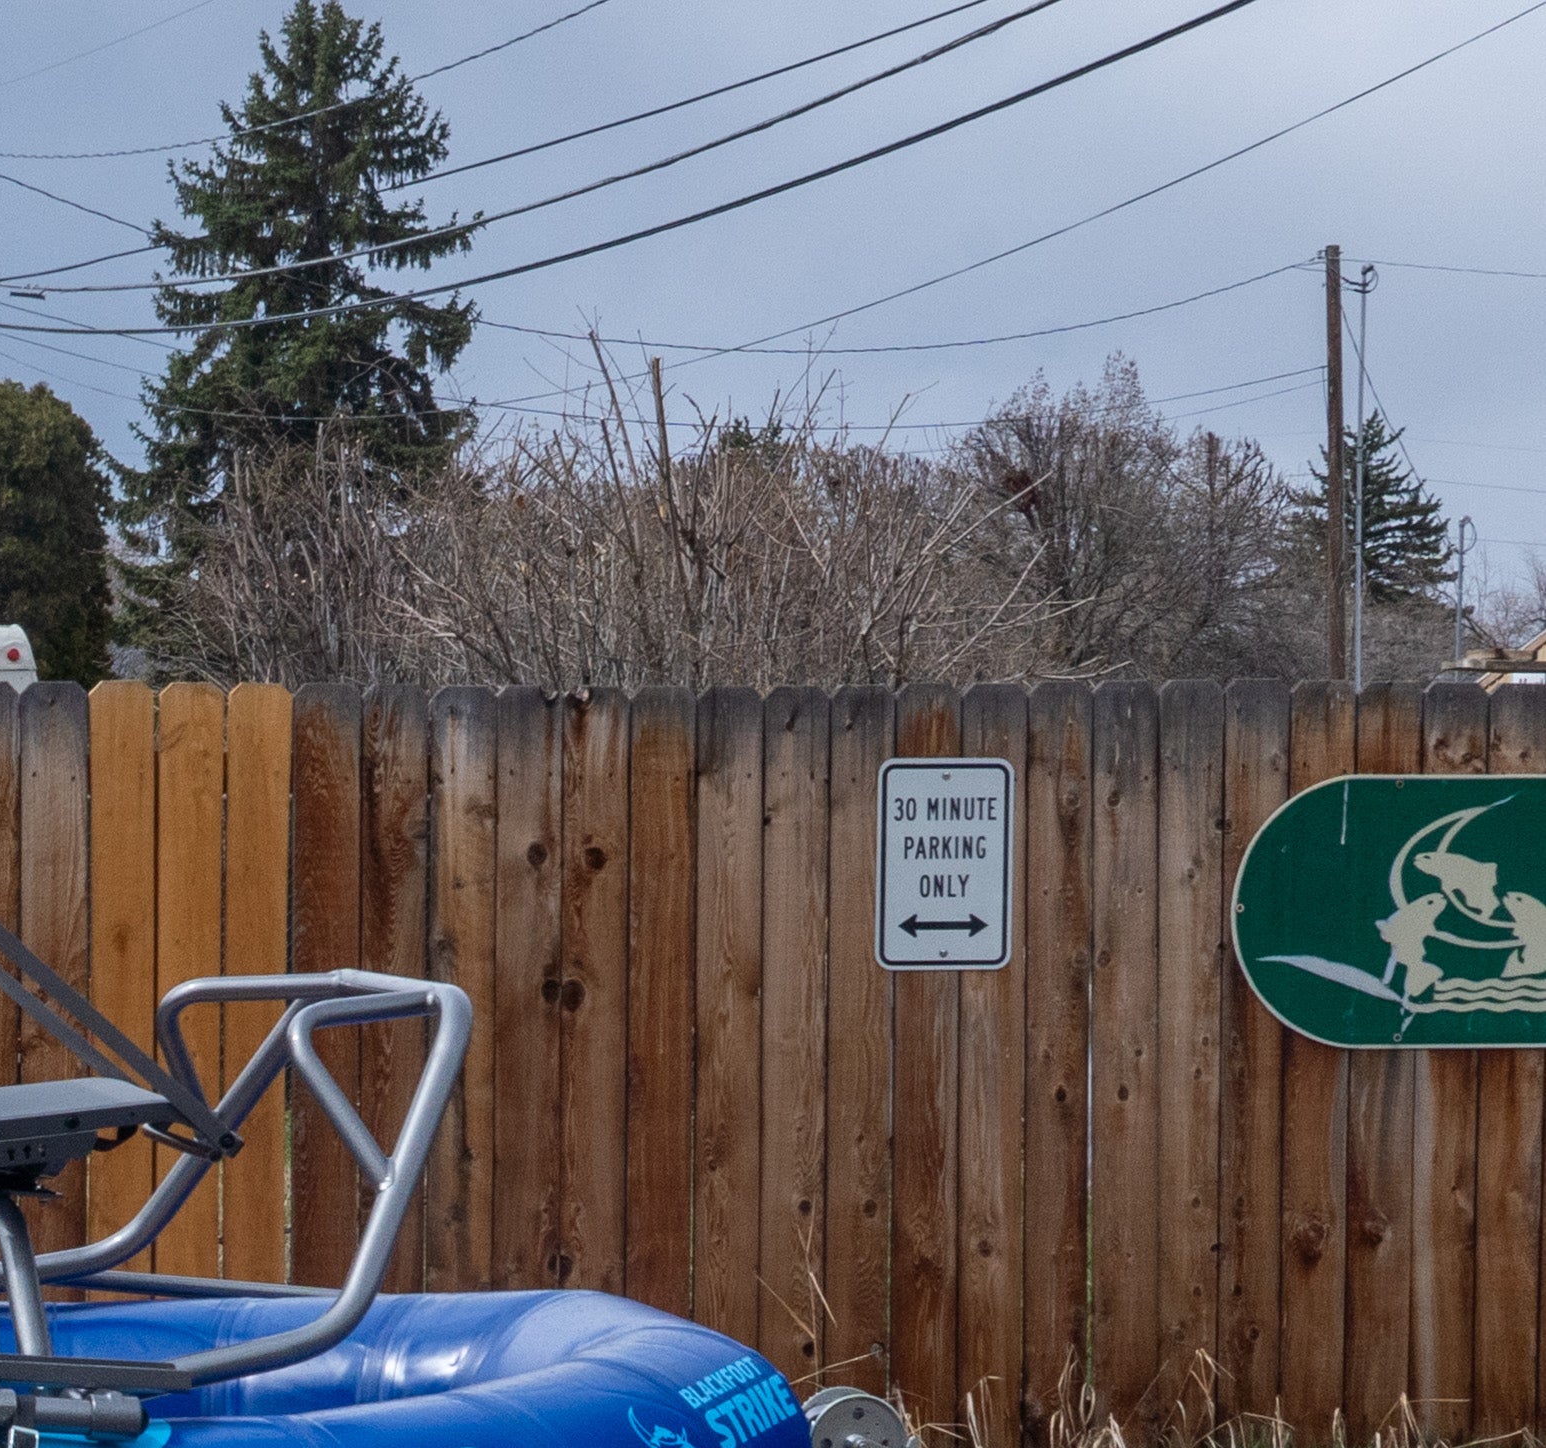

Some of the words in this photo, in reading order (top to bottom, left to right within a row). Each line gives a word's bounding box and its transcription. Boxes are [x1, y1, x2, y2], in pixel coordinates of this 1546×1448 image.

[893, 797, 917, 821] 30
[927, 797, 997, 821] MINUTE
[904, 835, 987, 860] PARKING
[919, 874, 970, 898] ONLY
[678, 1355, 762, 1410] BLACKFOOT
